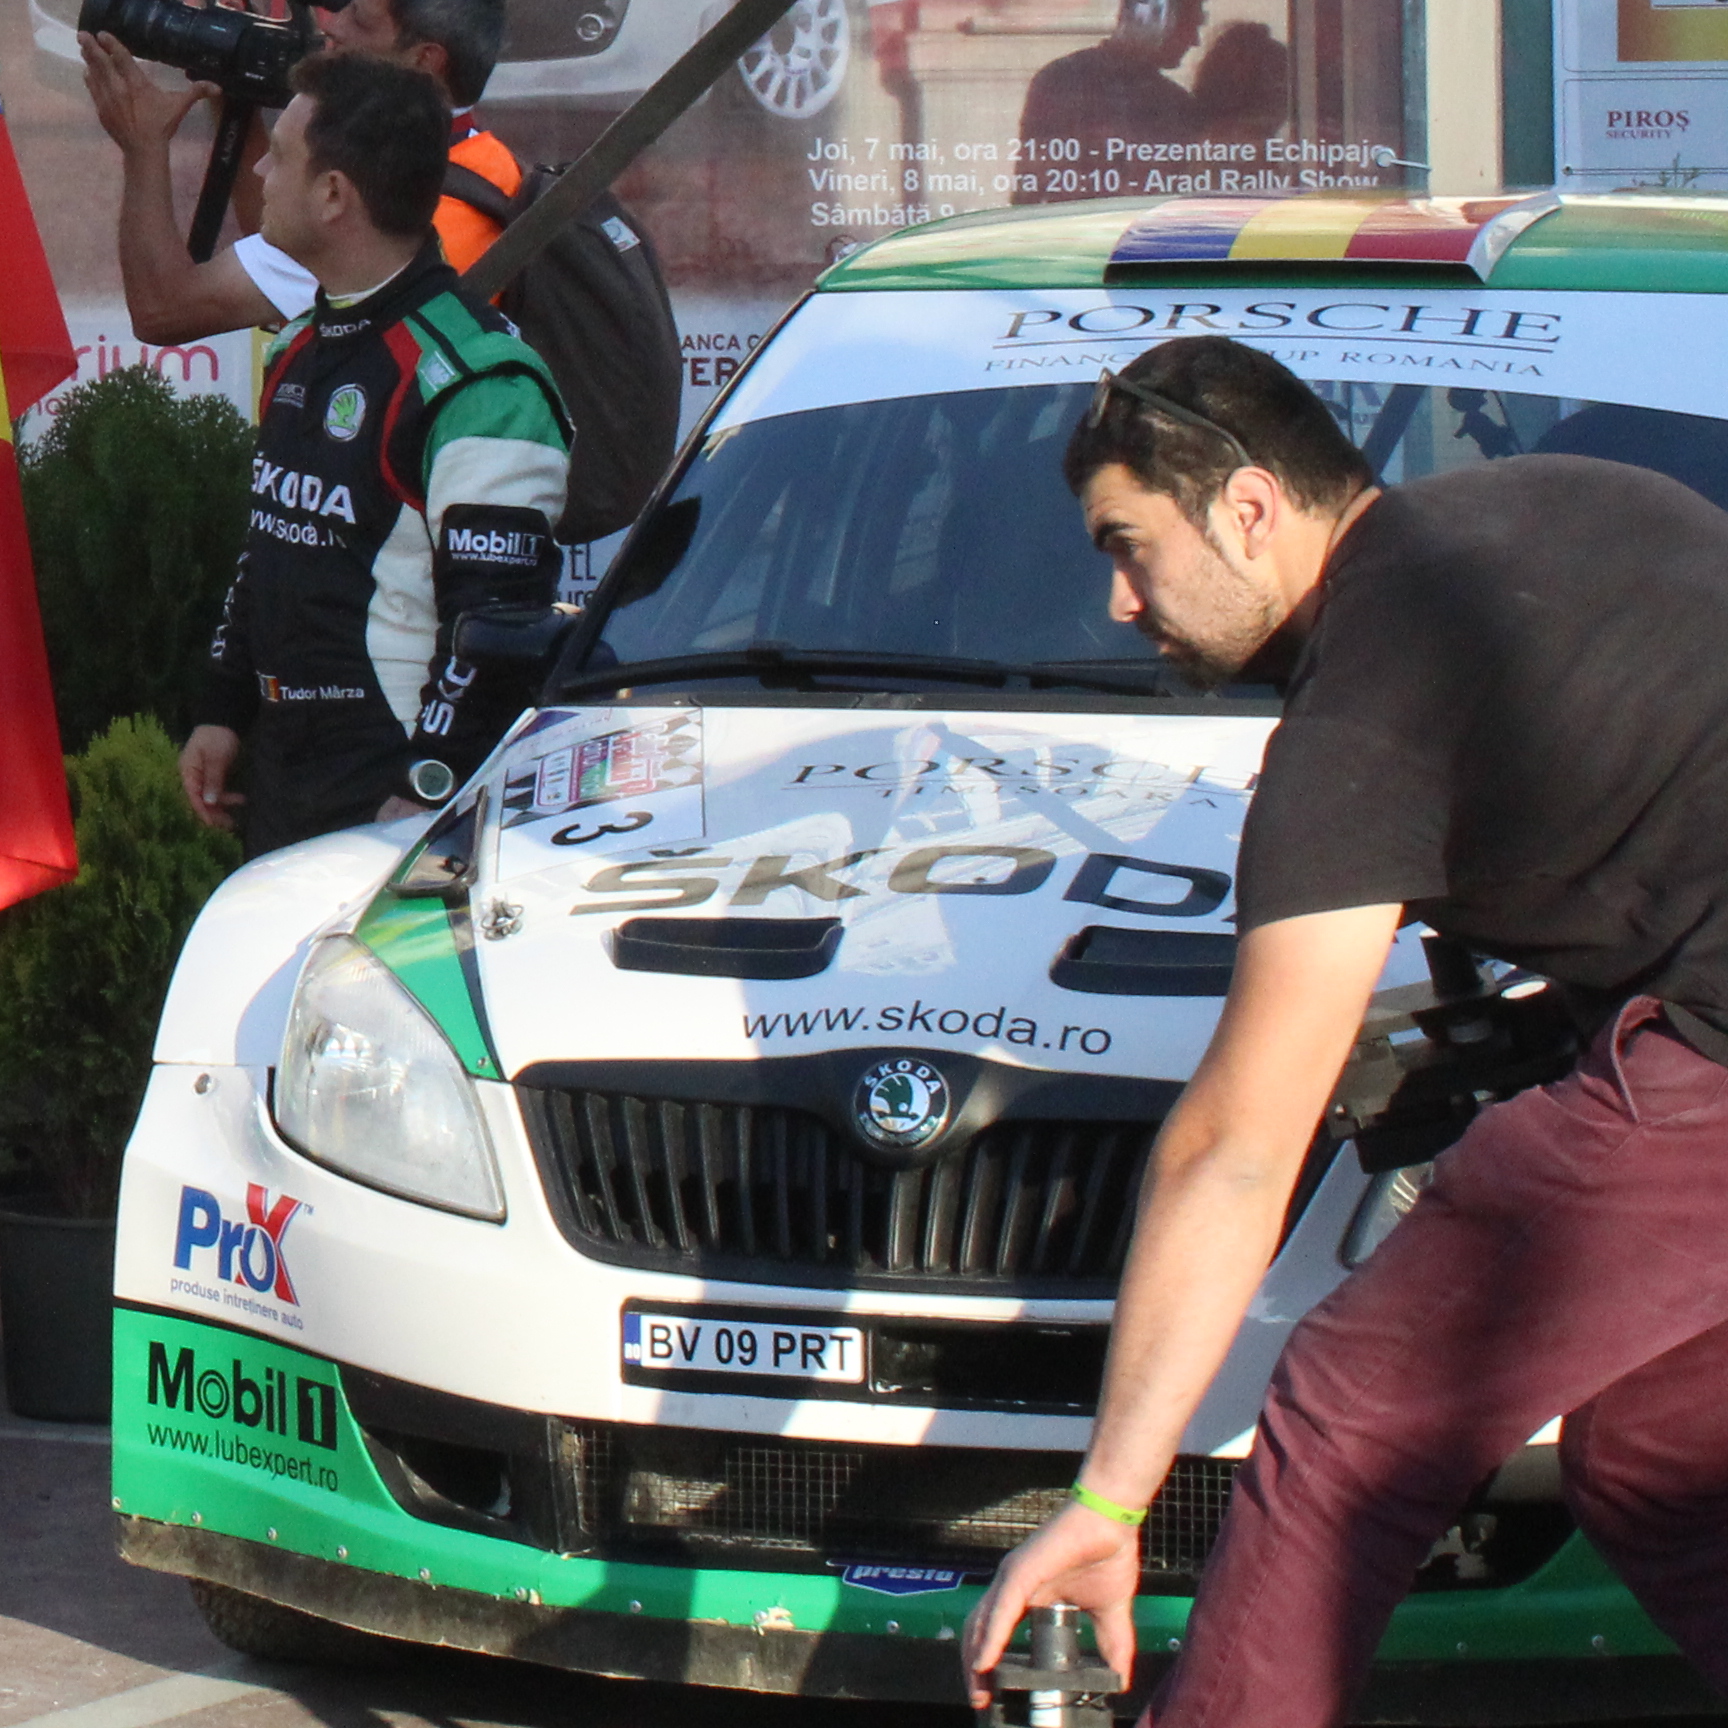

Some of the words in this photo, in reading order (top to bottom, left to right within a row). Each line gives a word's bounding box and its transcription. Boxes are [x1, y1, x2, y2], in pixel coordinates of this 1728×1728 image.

[807, 138, 856, 166] Joi,
[866, 139, 882, 162] 7
[888, 138, 946, 165] mai,
[953, 142, 999, 162] ora
[1007, 138, 1081, 162] 21:00
[1106, 138, 1256, 163] Prezentare
[1606, 128, 1672, 140] SECURITY
[808, 168, 892, 196] Vineri,
[903, 169, 918, 192] 8
[928, 168, 985, 196] mai,
[993, 172, 1038, 193] ora
[1046, 169, 1120, 193] 20:10
[1145, 168, 1209, 193] Arad
[1217, 169, 1293, 193] Rally
[1000, 301, 1562, 342] PORSCHE
[1341, 351, 1545, 377] ROMANIA
[448, 528, 522, 555] Mobil
[279, 685, 317, 700] Tudor
[570, 845, 1238, 925] ŠKOD
[741, 999, 1112, 1057] www.skoda.ro
[170, 1276, 221, 1302] produse
[281, 1311, 304, 1331] auto
[649, 1324, 702, 1361] BV
[714, 1327, 758, 1365] 09
[772, 1331, 854, 1371] PRT
[147, 1340, 287, 1436] Mobil
[147, 1422, 339, 1492] www.lubexpert.ro
